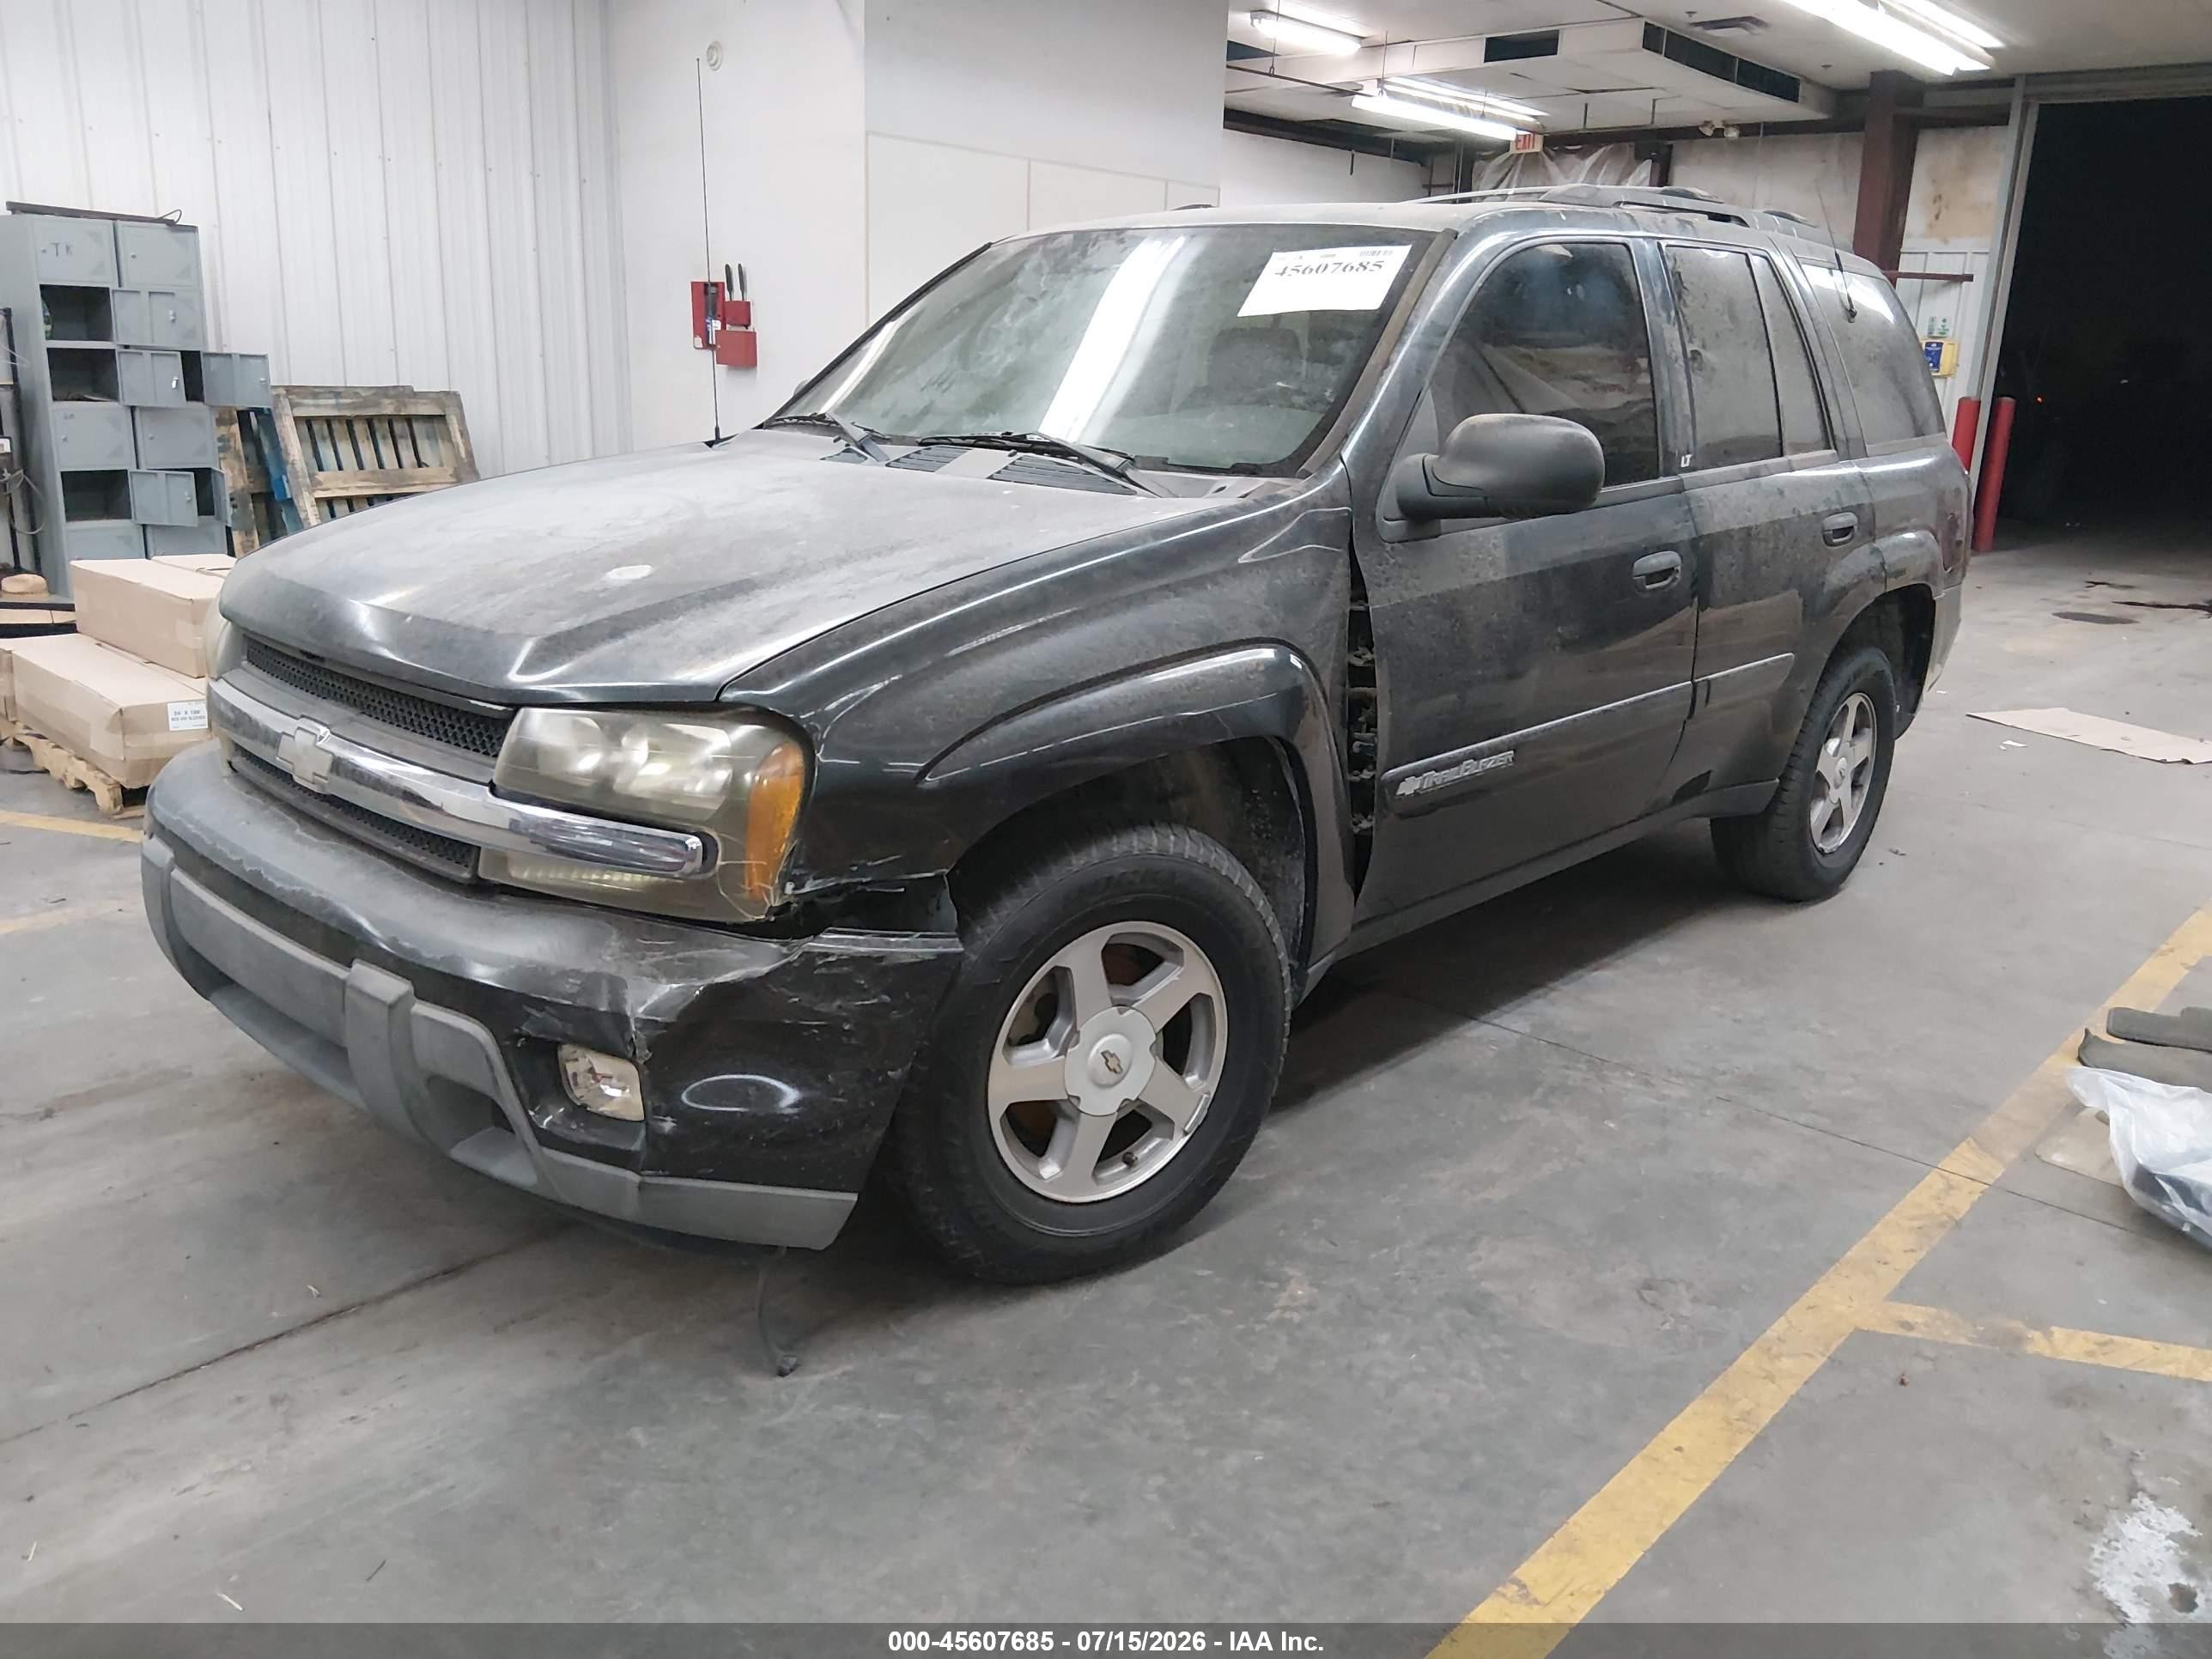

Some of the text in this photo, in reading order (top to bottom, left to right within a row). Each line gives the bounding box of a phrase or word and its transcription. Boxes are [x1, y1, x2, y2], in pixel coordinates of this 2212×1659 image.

[1516, 133, 1537, 150] EXIT
[1274, 259, 1385, 276] 45607685
[1680, 453, 1692, 468] LT
